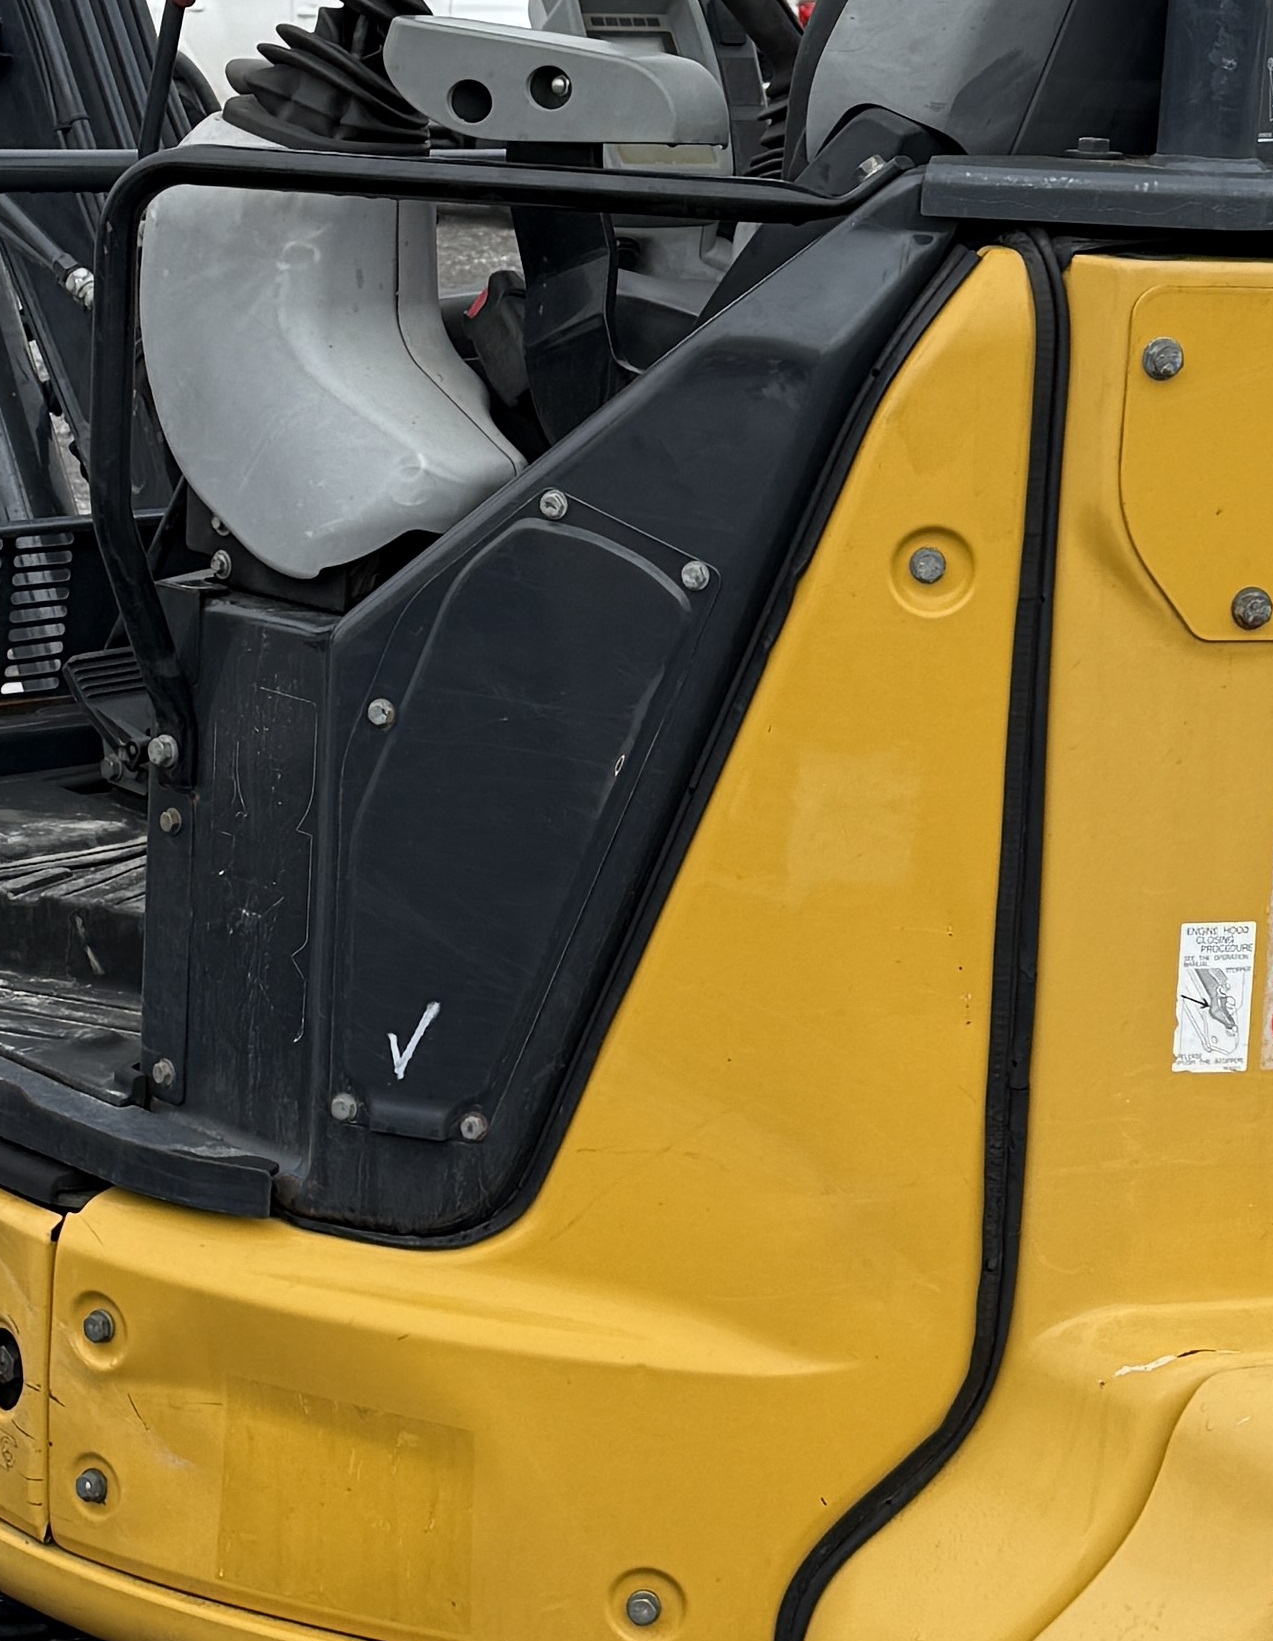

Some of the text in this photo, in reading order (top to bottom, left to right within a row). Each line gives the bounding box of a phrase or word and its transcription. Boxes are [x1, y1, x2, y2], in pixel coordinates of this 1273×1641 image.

[1187, 926, 1249, 936] ENGINE HOOD
[1196, 935, 1234, 945] CLOSING
[1200, 943, 1254, 953] PROCEDURE
